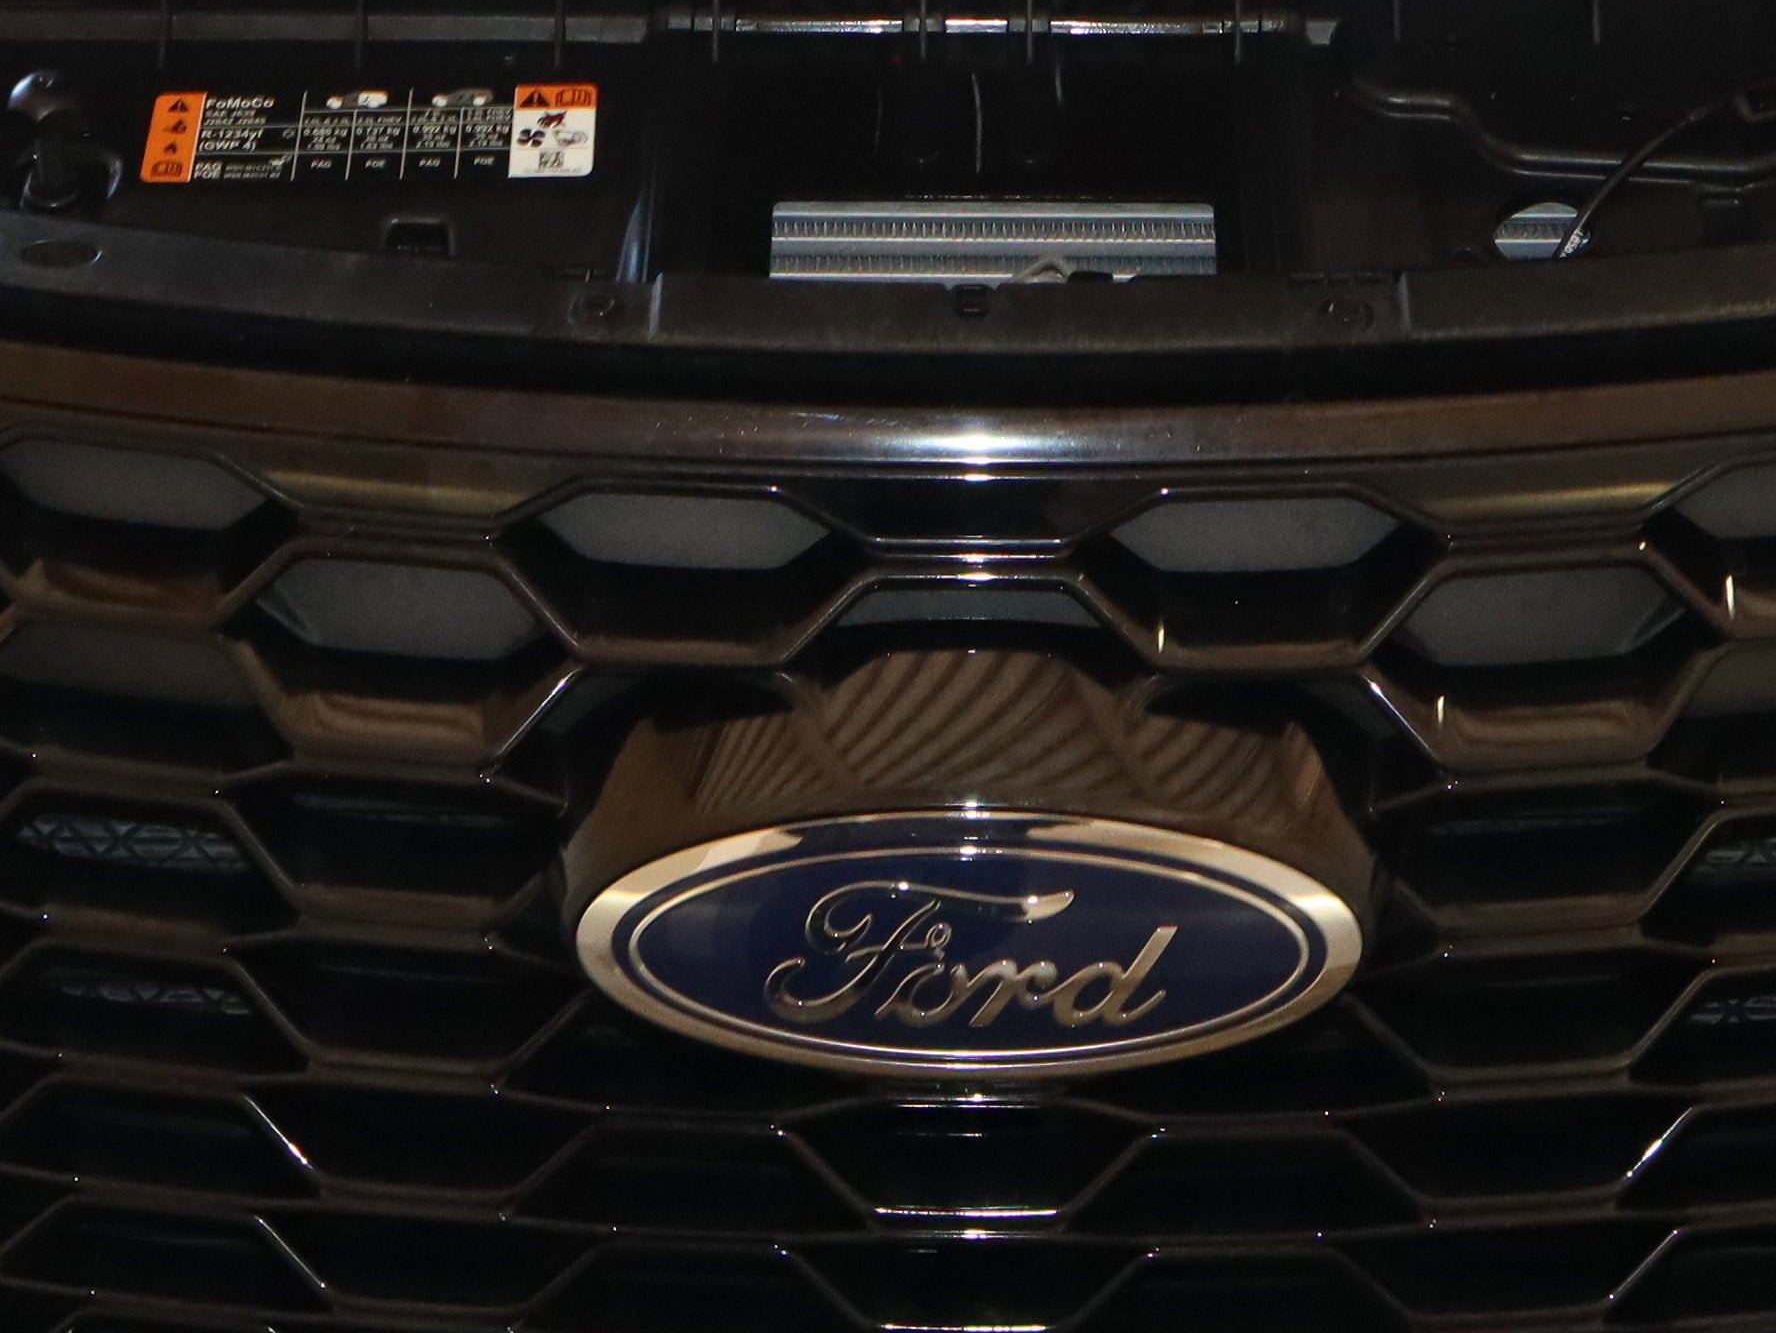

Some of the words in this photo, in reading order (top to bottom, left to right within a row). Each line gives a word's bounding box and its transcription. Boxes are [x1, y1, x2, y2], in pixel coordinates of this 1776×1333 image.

[206, 97, 275, 109] FoMoCo
[201, 128, 264, 142] R-1234yf
[199, 141, 240, 152] (GWP
[764, 878, 1169, 1028] Ford
